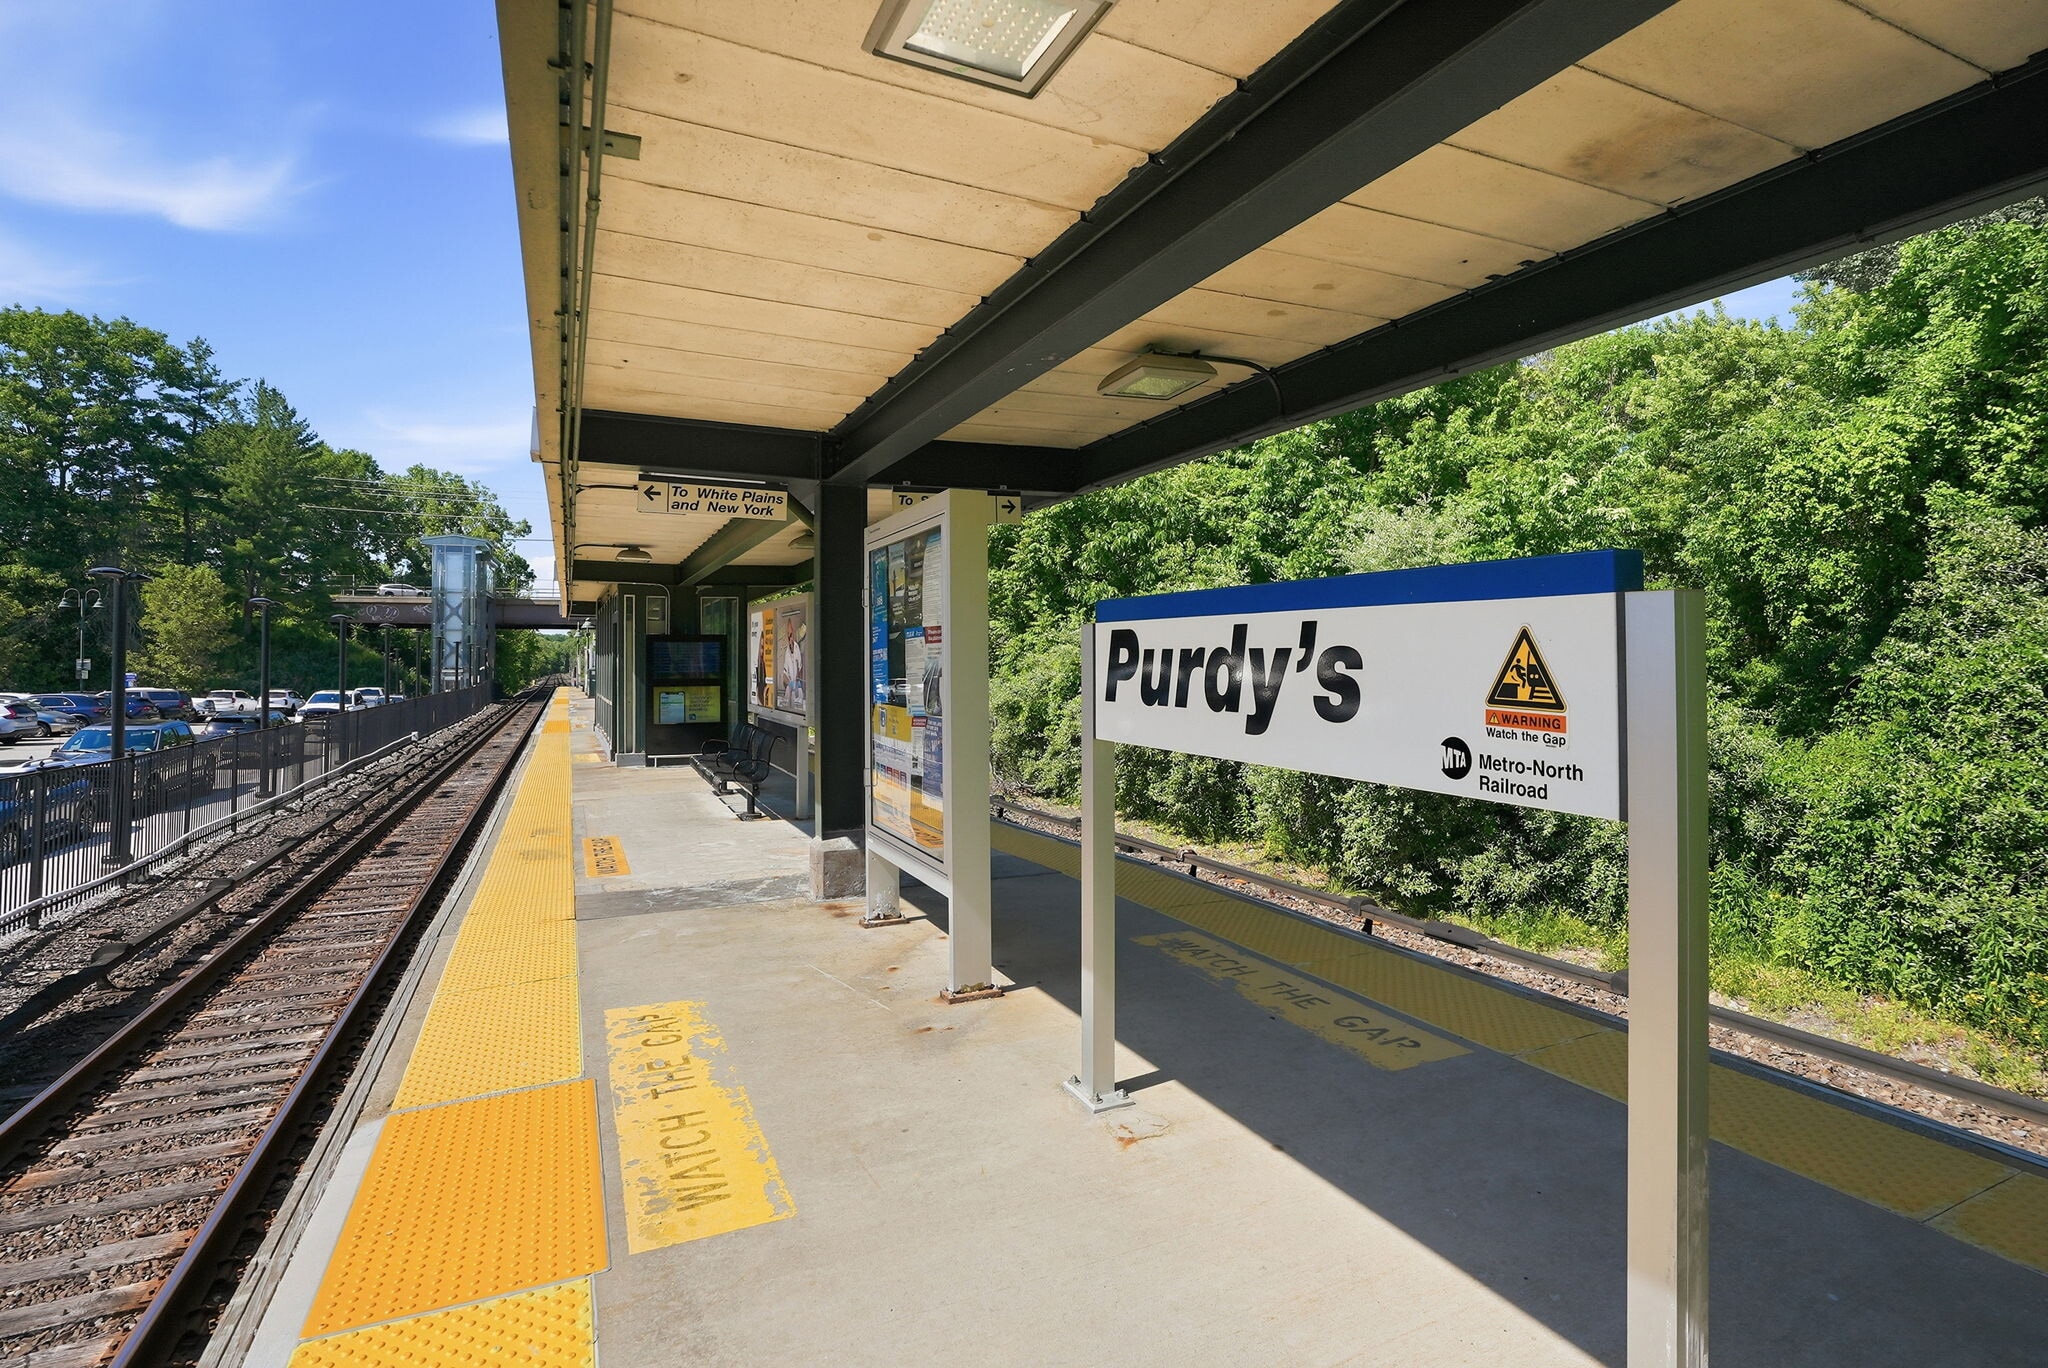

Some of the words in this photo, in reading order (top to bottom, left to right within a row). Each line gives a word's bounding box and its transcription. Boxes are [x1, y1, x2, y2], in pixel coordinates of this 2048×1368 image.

[671, 501, 699, 511] and
[707, 502, 739, 514] New
[744, 504, 774, 516] York
[672, 486, 688, 497] To
[697, 488, 738, 501] White
[742, 491, 784, 504] Plains
[898, 495, 913, 506] To
[1105, 620, 1363, 735] Purdy's
[1501, 713, 1561, 730] WARNING
[1486, 727, 1518, 740] Watch
[1522, 731, 1539, 742] the
[1542, 733, 1566, 747] Gap
[1441, 743, 1468, 771] MTA
[1479, 753, 1583, 782] Metro-North
[1479, 775, 1548, 800] Railroad
[1171, 939, 1259, 976] WATCH
[1258, 981, 1331, 1010] THE
[1333, 1015, 1421, 1049] GAP
[638, 1014, 683, 1047] GAP
[646, 1054, 698, 1100] THE
[657, 1110, 731, 1213] WATCH
